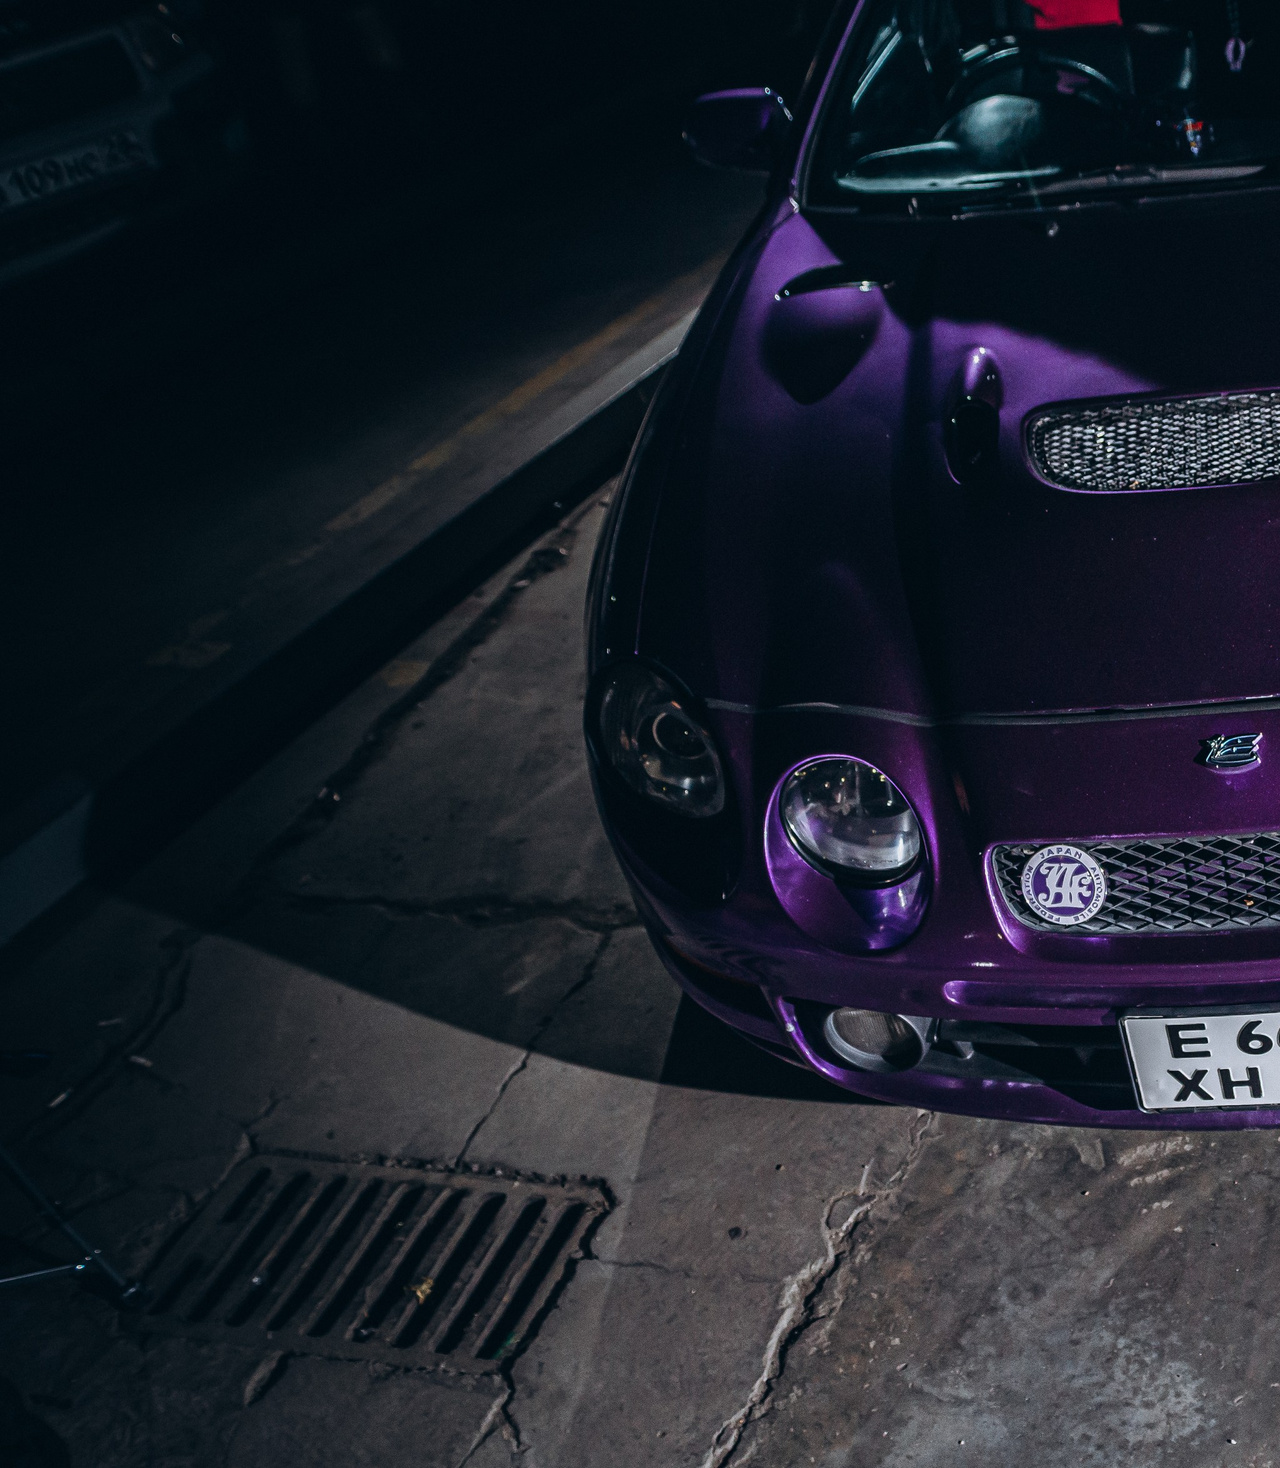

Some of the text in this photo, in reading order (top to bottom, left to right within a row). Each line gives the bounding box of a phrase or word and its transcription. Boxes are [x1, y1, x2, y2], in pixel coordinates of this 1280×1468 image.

[1039, 846, 1083, 859] JAPAN
[1024, 865, 1060, 922] FEDERATION
[1073, 866, 1103, 922] AUTOMOBILE
[1165, 1023, 1211, 1059] E
[1166, 1066, 1264, 1101] XH
